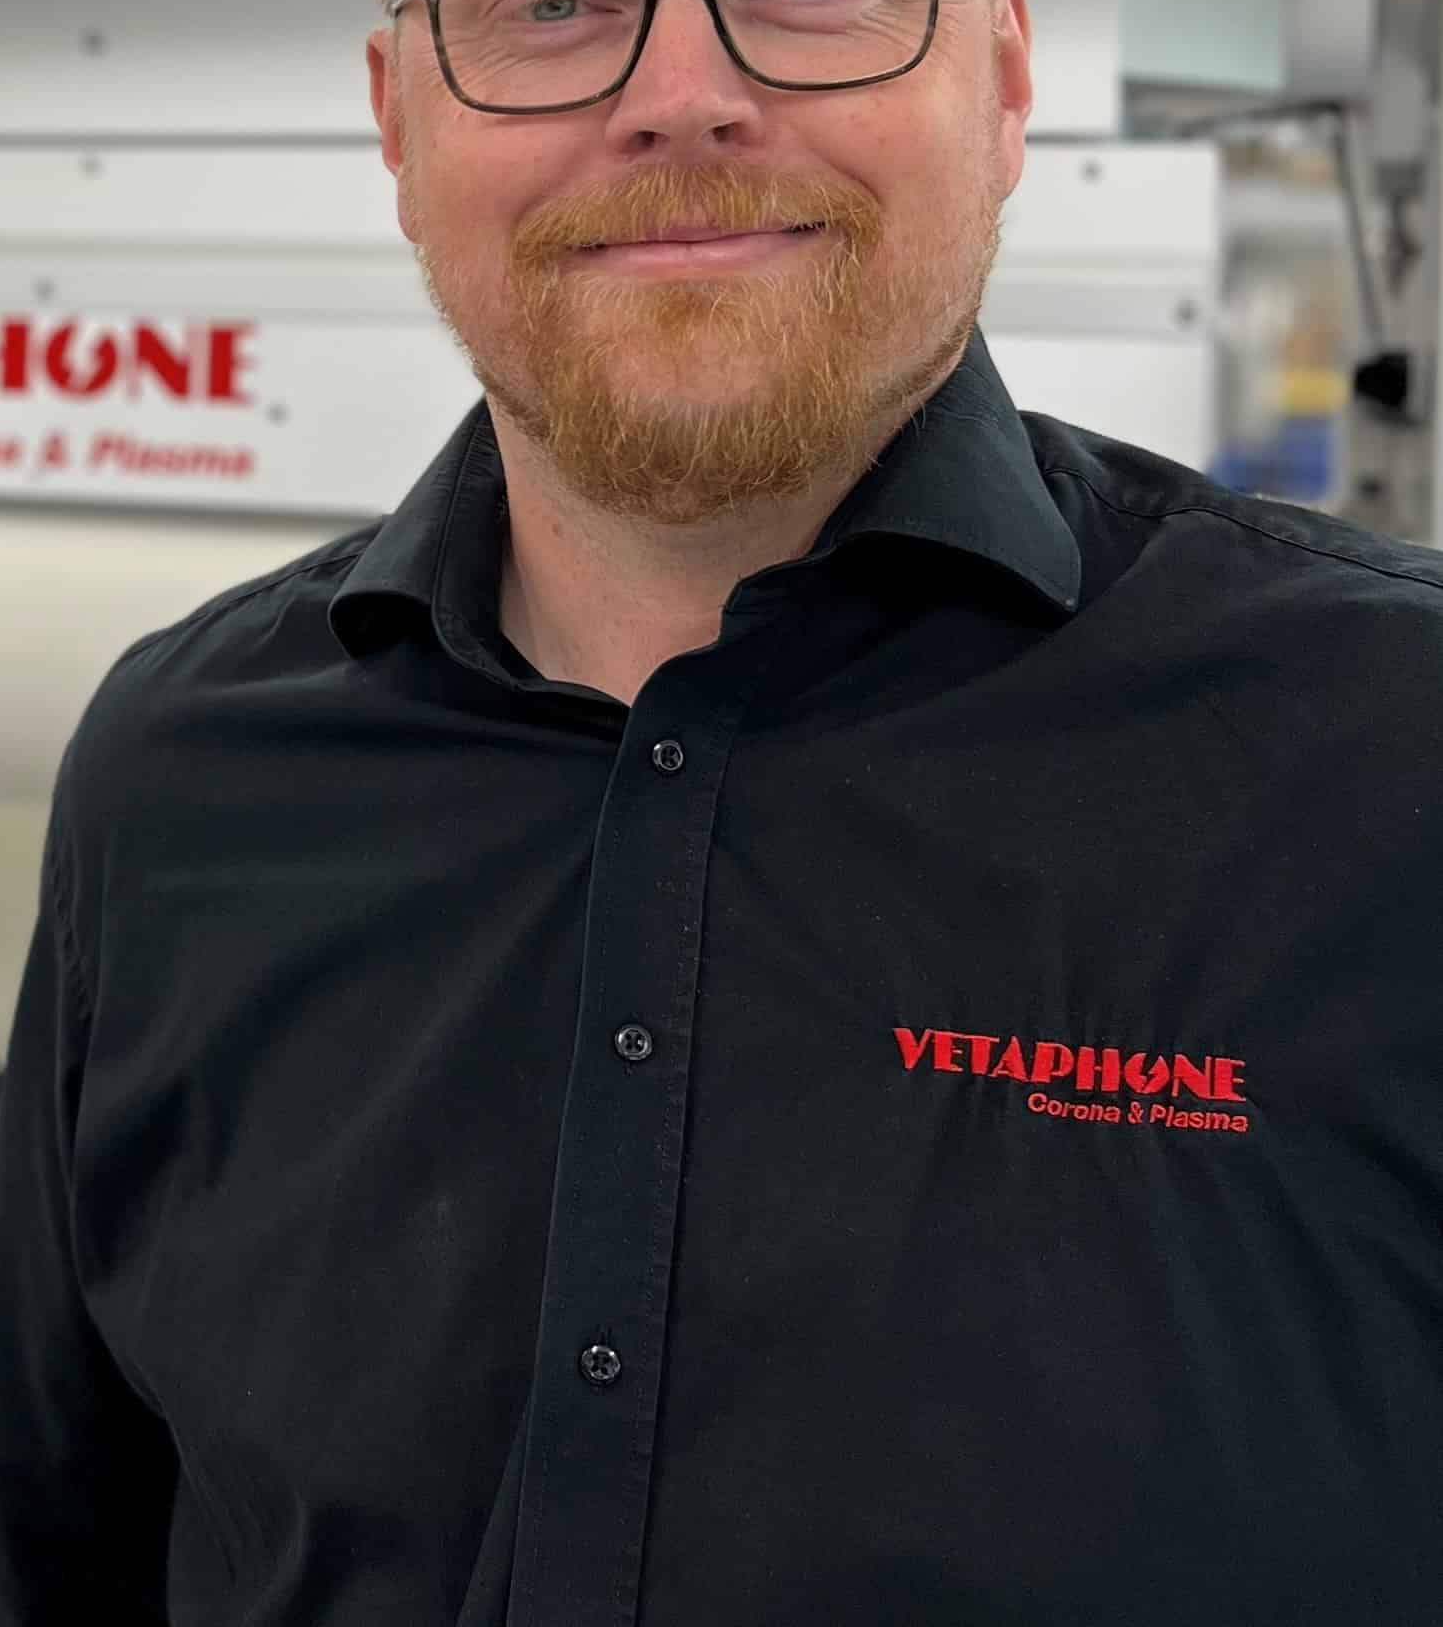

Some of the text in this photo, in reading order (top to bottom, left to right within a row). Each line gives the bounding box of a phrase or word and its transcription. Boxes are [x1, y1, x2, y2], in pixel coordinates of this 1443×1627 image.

[90, 431, 258, 479] Plasma
[892, 1027, 1246, 1102] VETAPHONE
[1027, 1092, 1248, 1133] Corona & Plasma
